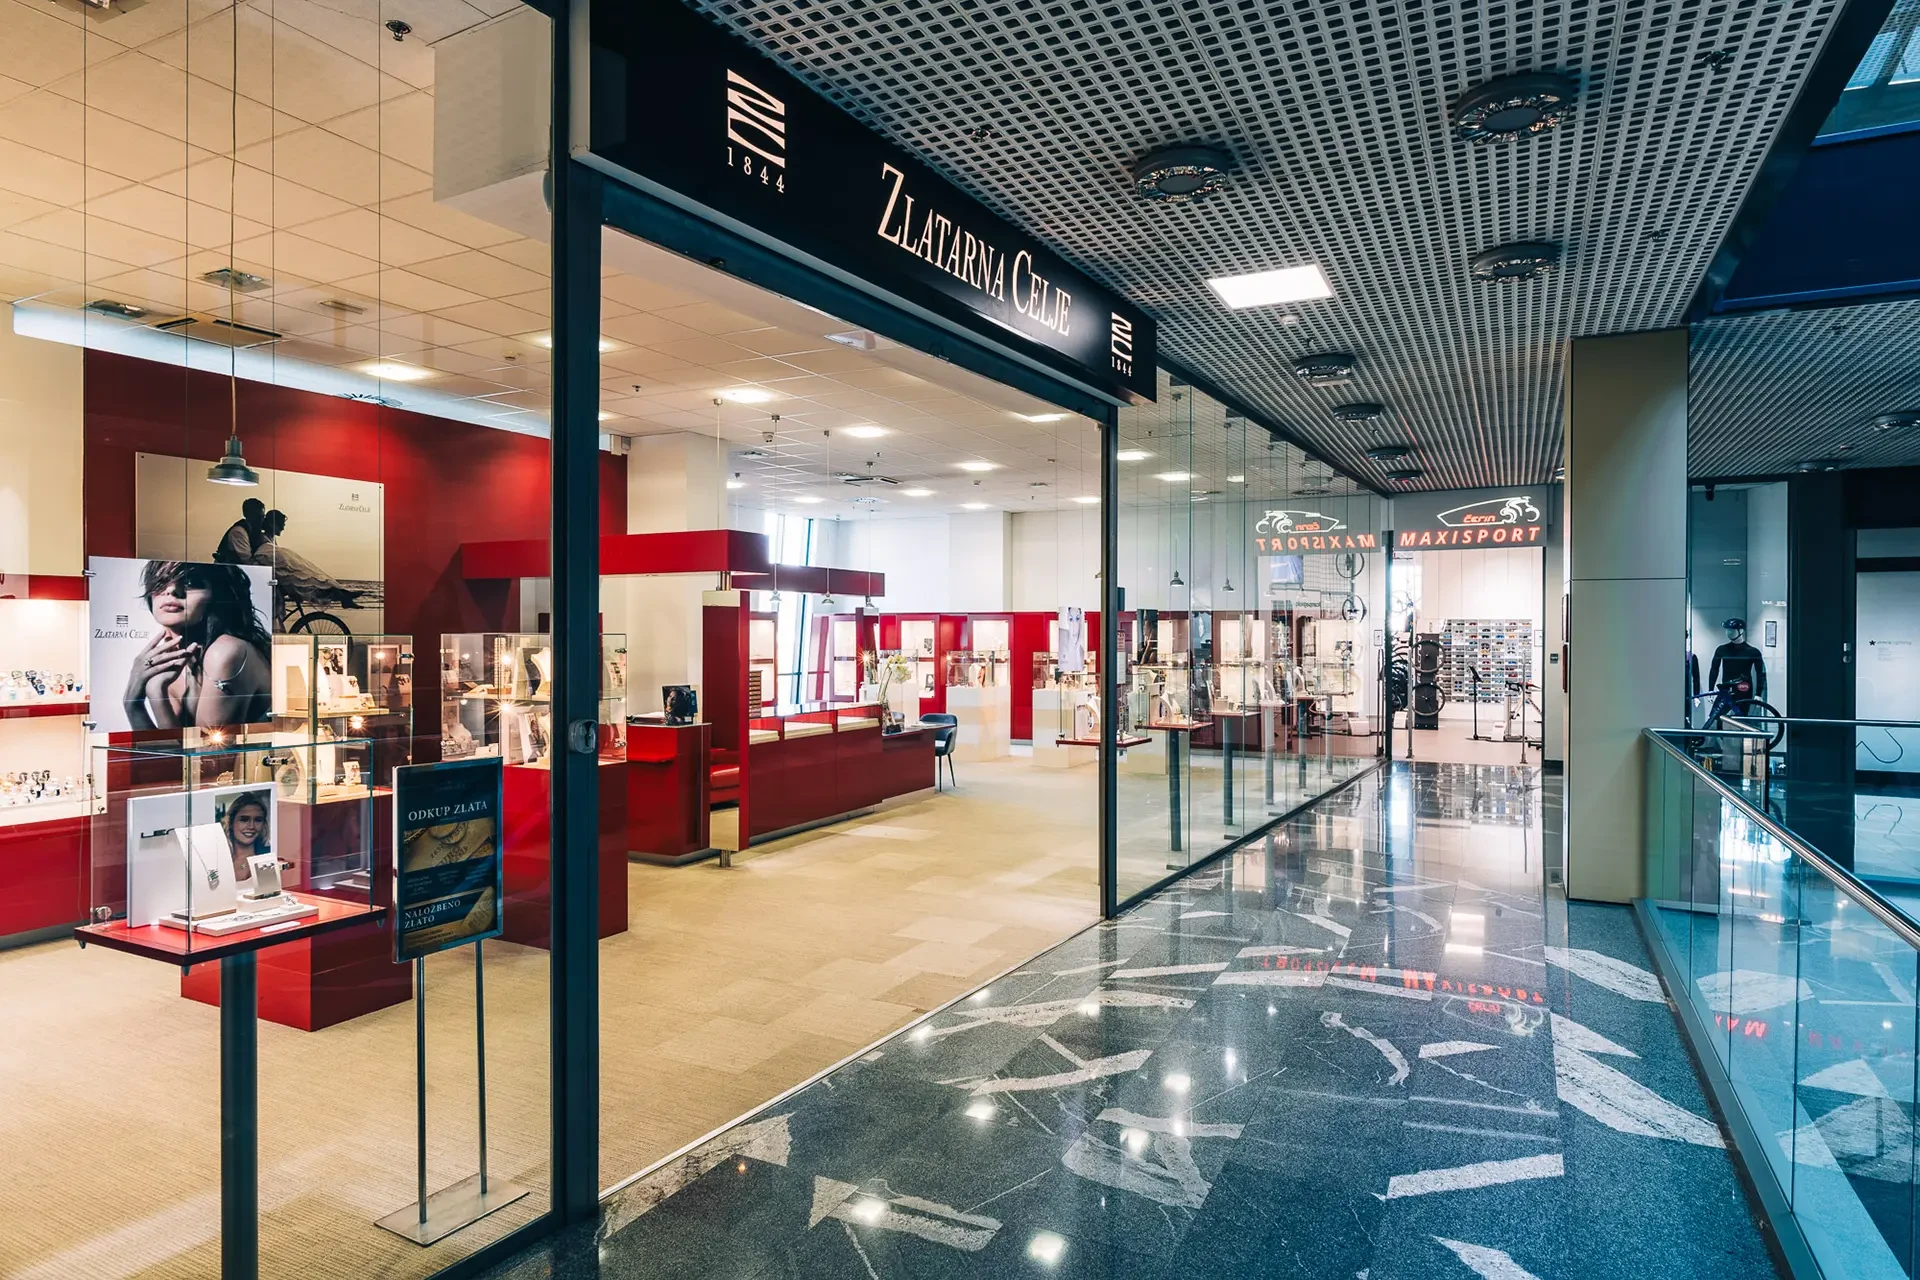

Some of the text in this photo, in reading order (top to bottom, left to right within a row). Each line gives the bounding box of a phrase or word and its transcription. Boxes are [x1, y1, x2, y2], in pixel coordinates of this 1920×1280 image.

[727, 146, 785, 194] 1844
[877, 162, 1072, 337] ZLATARNA CELJE
[1111, 355, 1132, 378] 1844
[1399, 526, 1541, 547] MAXISPORT
[408, 800, 488, 822] ODKUP ZLATA
[404, 914, 435, 929] ZLATO
